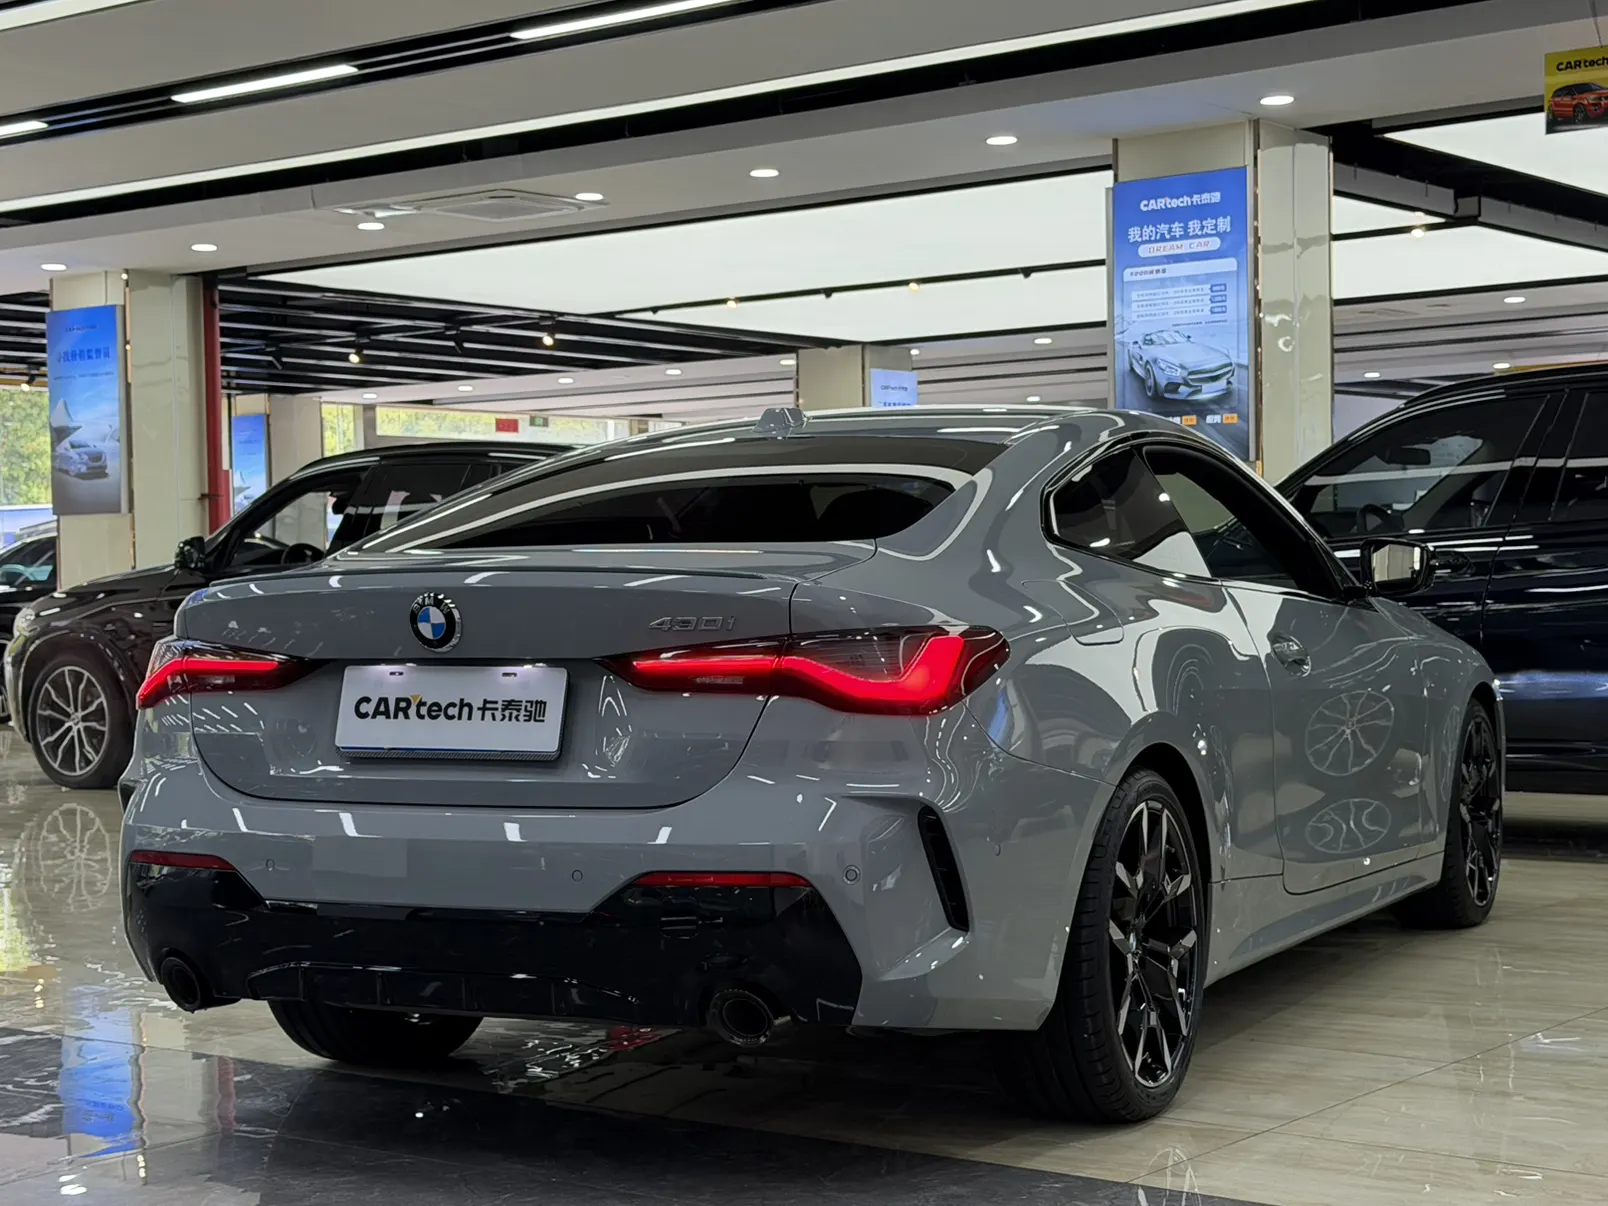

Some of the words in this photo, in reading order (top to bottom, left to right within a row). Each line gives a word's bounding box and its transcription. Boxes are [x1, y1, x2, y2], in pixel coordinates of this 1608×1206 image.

[1128, 222, 1185, 243] 我的汽车
[1187, 215, 1231, 236] 我定制
[1148, 243, 1184, 254] DREAM
[1188, 240, 1211, 250] CAR
[649, 615, 736, 631] 430i
